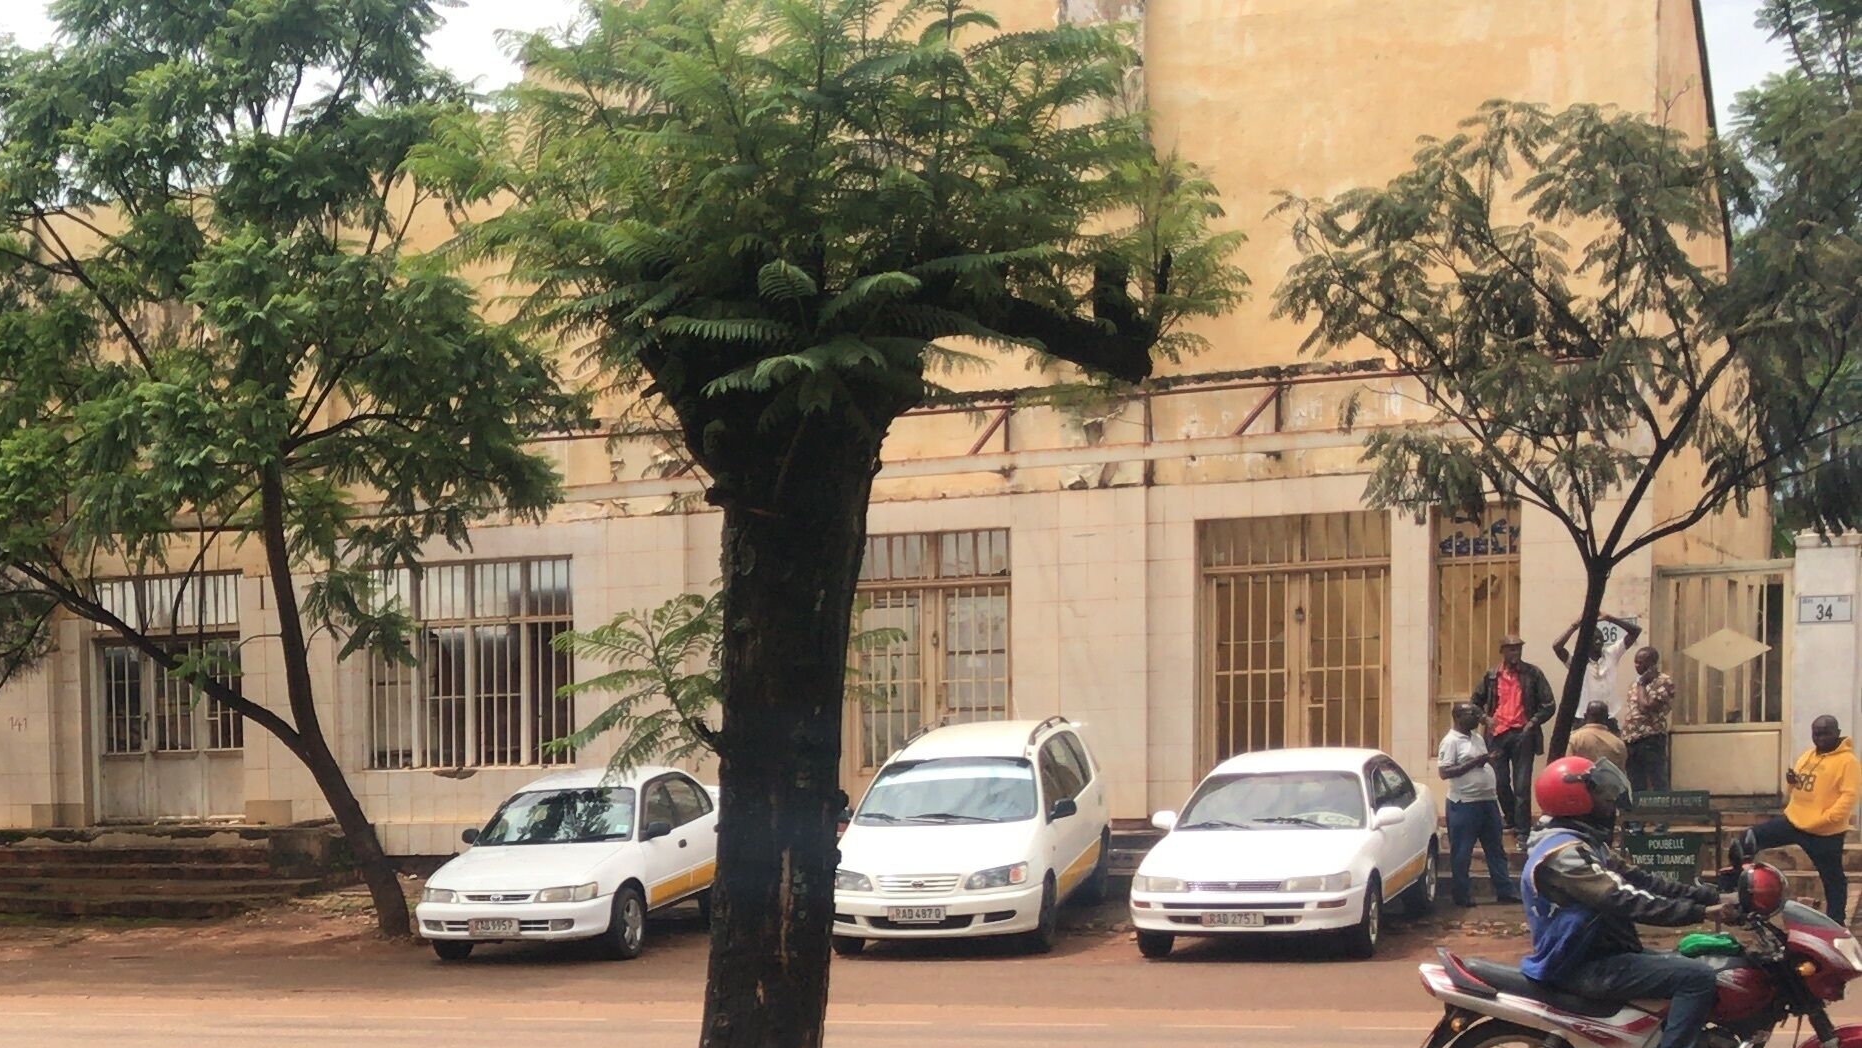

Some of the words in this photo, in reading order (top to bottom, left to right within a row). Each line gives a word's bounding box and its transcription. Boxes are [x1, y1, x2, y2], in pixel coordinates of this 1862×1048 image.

[1816, 603, 1833, 621] 34
[1602, 626, 1618, 642] 36
[1648, 838, 1685, 850] POUBELLE
[895, 908, 914, 919] RAD
[1209, 914, 1229, 924] RAD
[1230, 914, 1250, 924] 275
